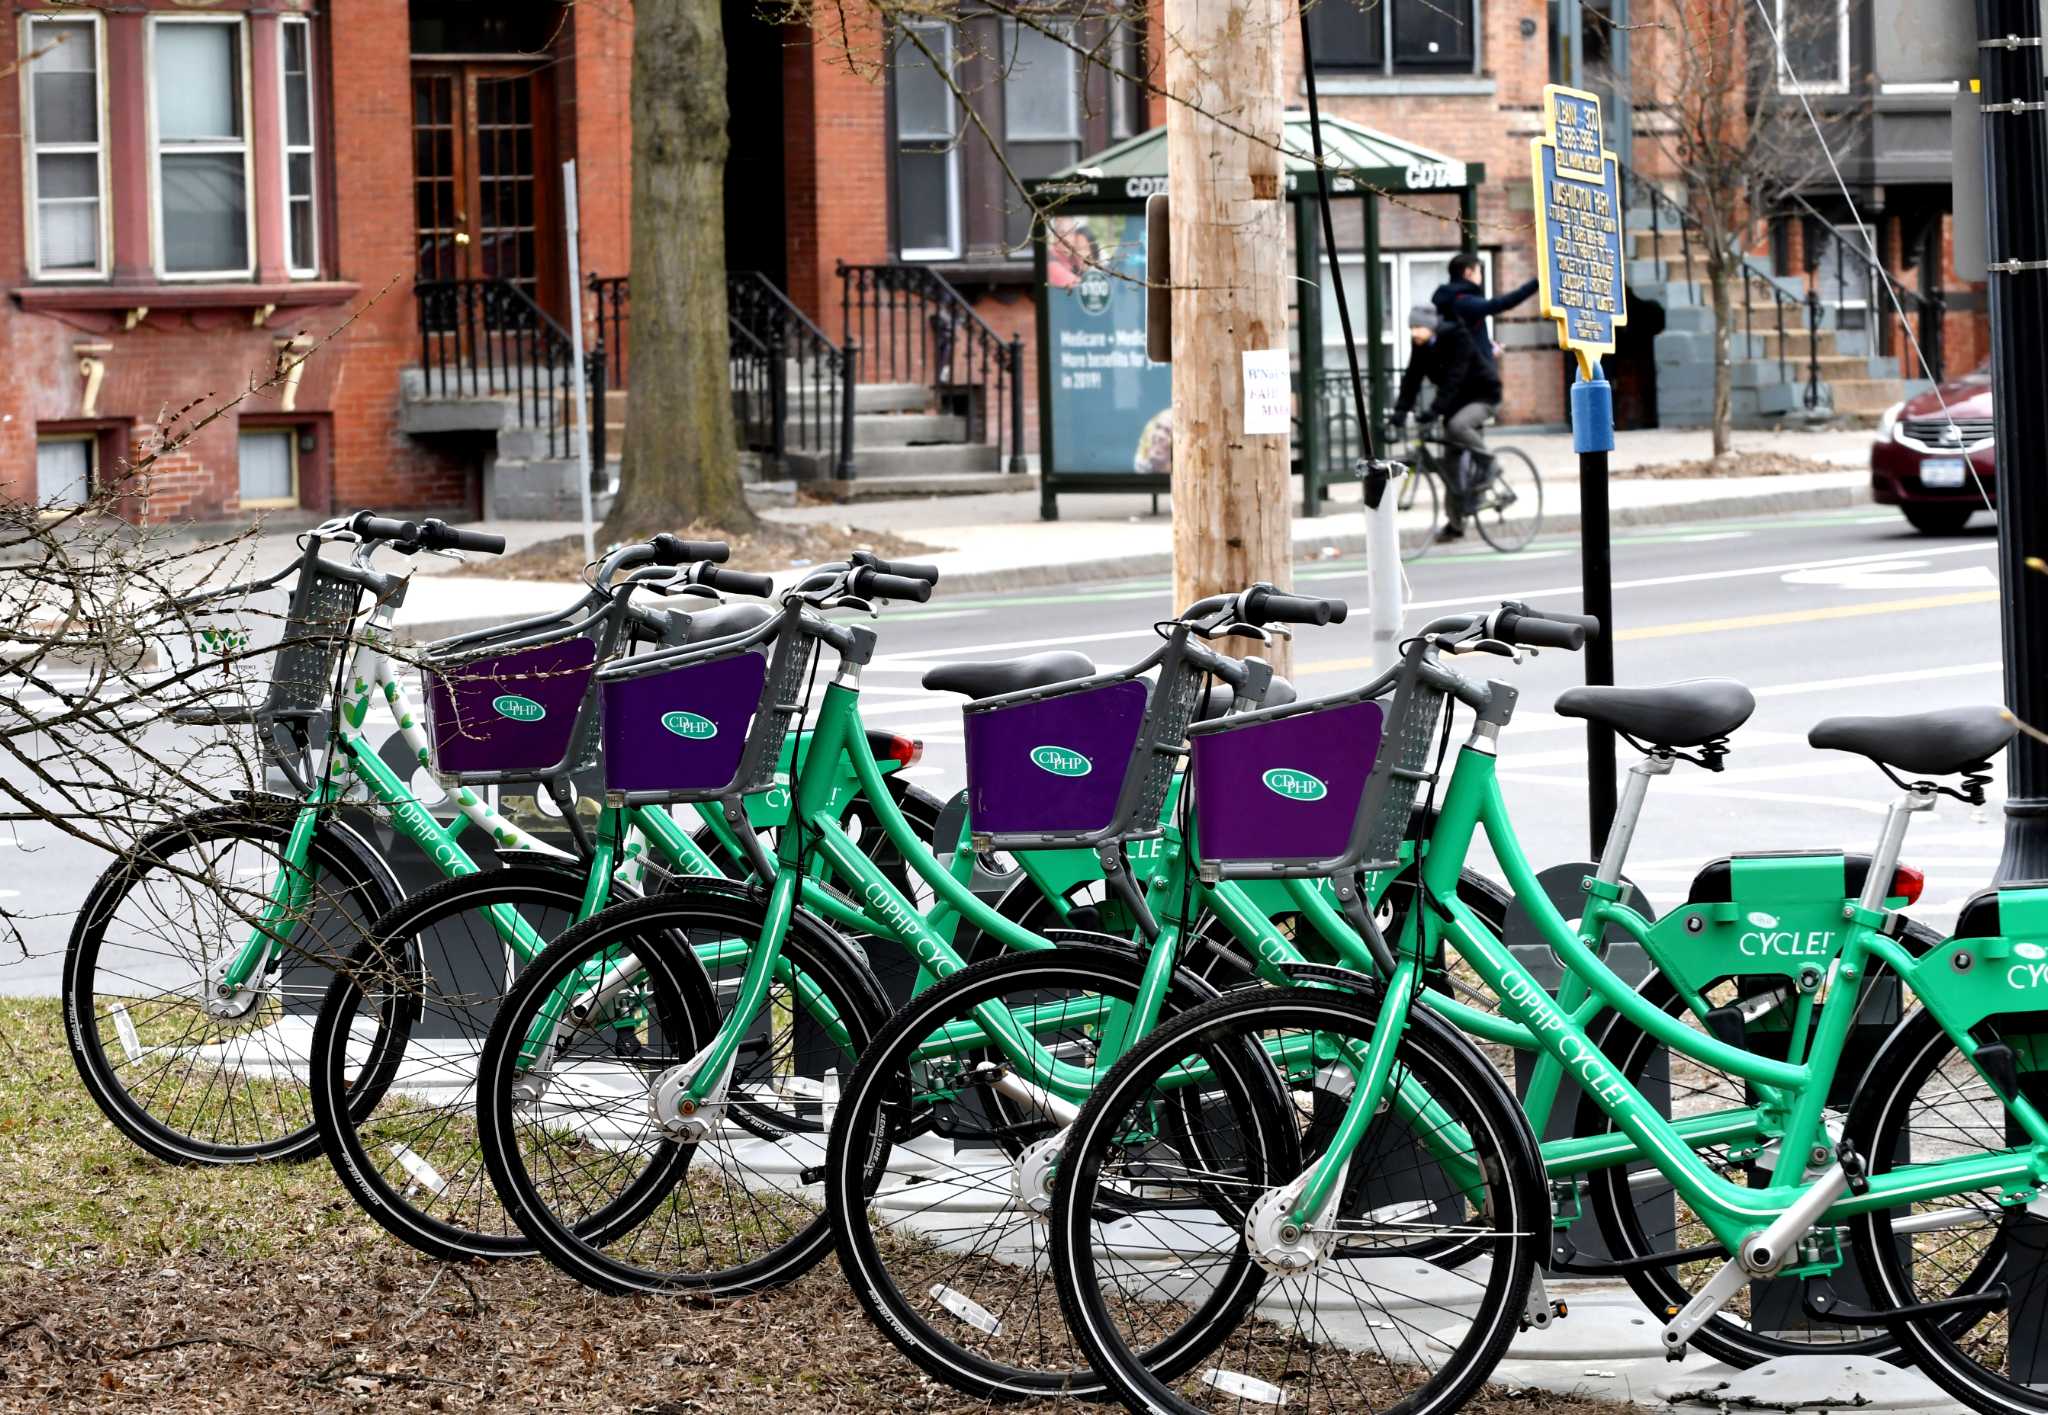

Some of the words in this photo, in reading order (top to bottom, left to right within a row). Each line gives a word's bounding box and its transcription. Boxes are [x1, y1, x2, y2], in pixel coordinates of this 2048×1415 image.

[1552, 180, 1591, 213] WASHINGTON
[1593, 189, 1610, 217] PARK
[1060, 330, 1105, 347] Medicare
[1061, 352, 1086, 368] More
[1087, 351, 1128, 368] benefits
[1128, 351, 1145, 368] for
[1061, 372, 1073, 389] in
[500, 700, 537, 716] CDPHP
[669, 716, 708, 733] CDPHP
[1039, 751, 1082, 770] CDPHP
[1271, 774, 1317, 794] CDPHP
[865, 882, 921, 935] CDPHP
[1739, 931, 1831, 956] CYCLE!
[1500, 969, 1565, 1031] CDPHP
[1559, 1035, 1632, 1108] CYCLE!
